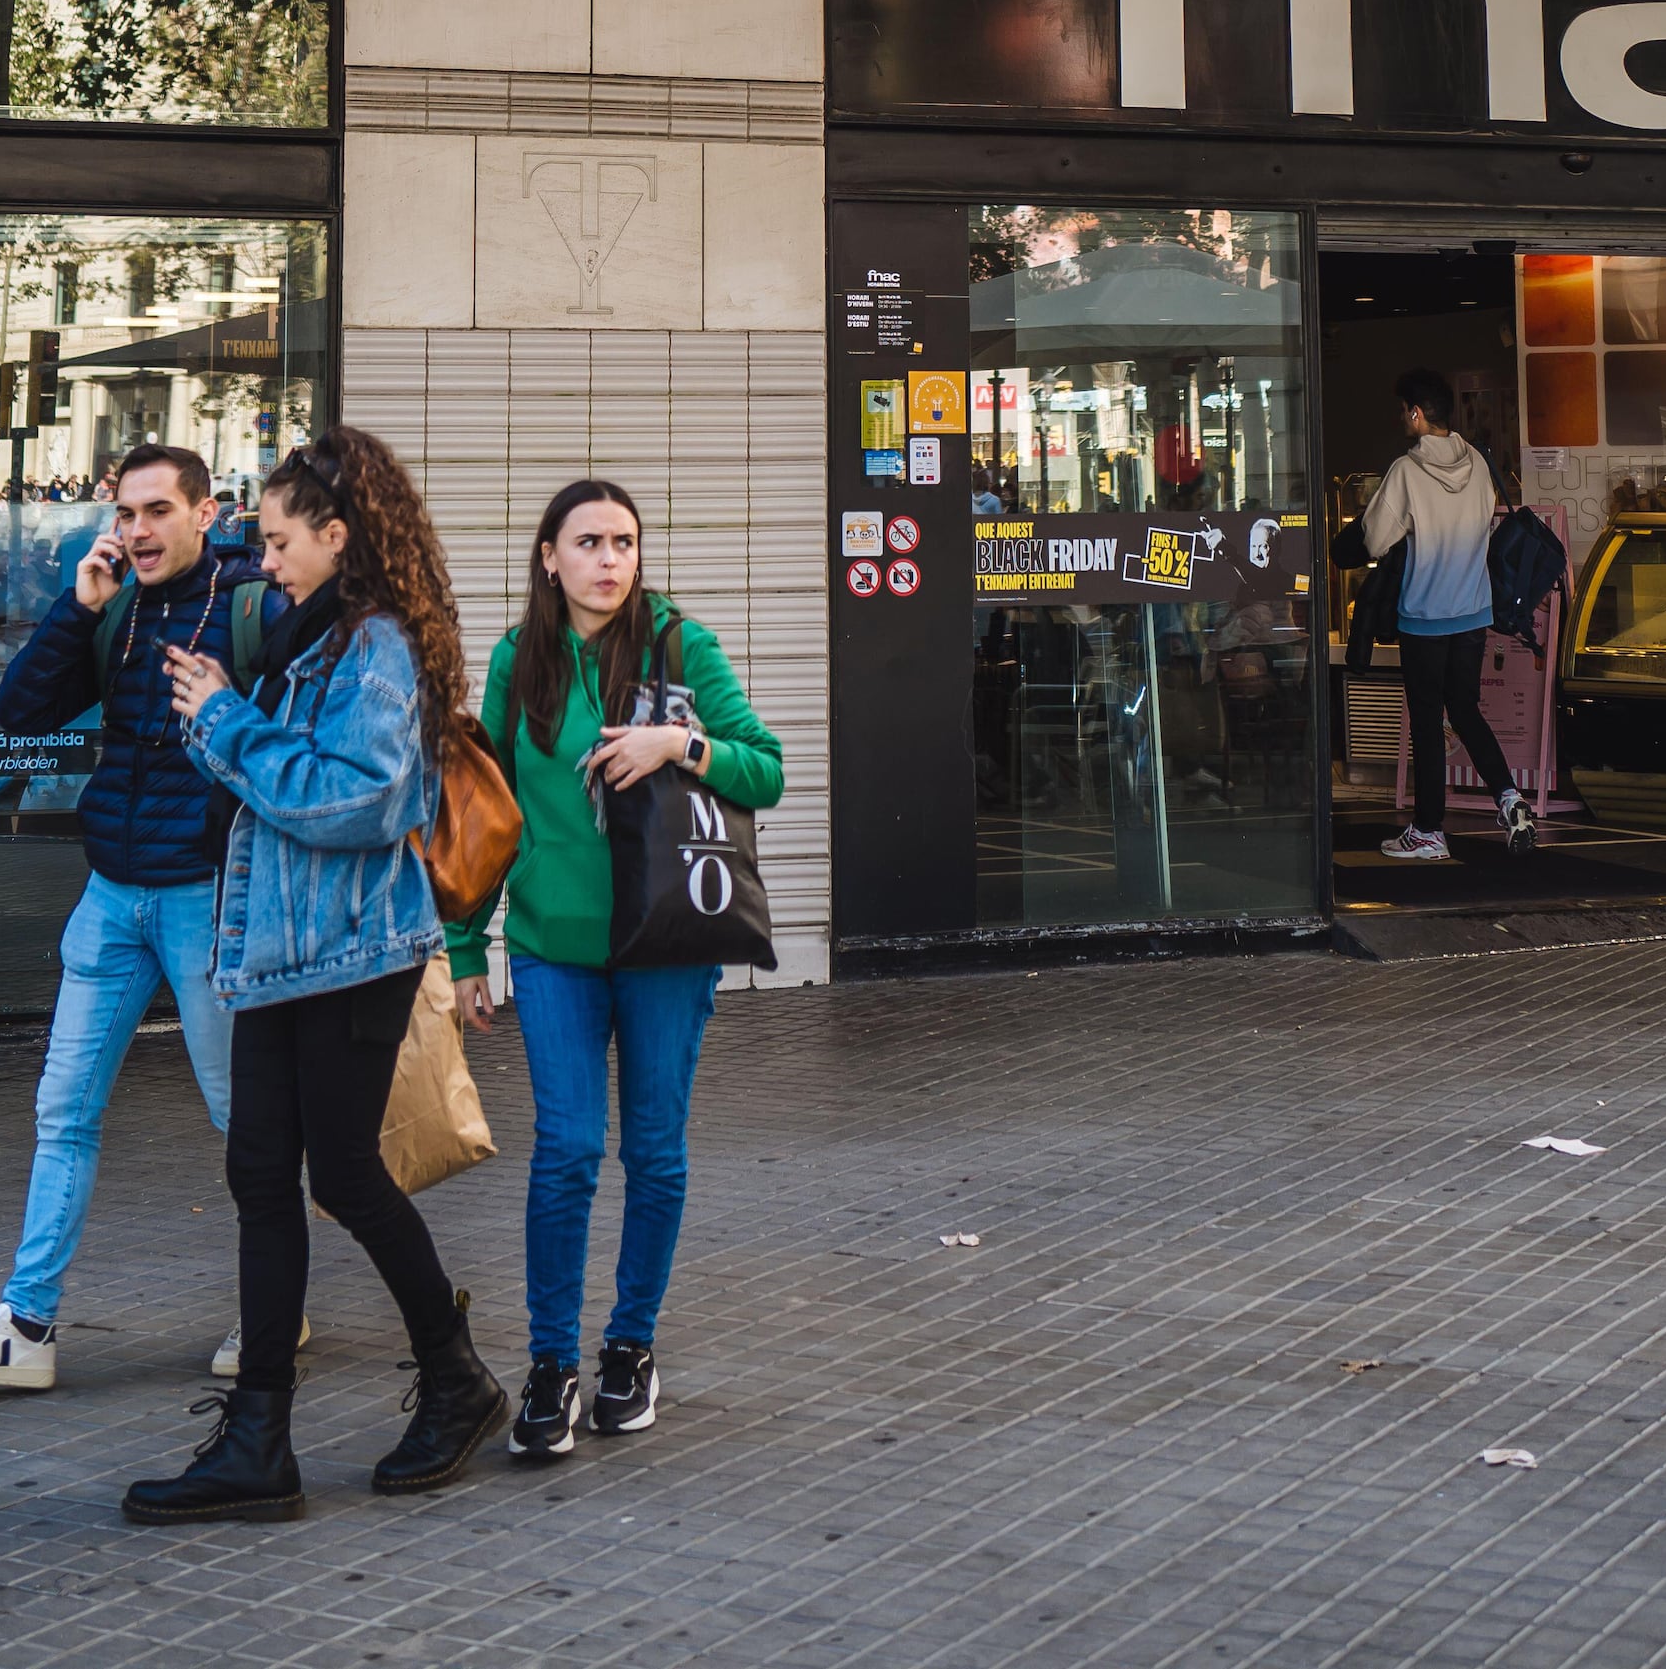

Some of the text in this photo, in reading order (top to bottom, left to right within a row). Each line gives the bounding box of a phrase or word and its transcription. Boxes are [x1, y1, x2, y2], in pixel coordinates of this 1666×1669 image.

[867, 270, 900, 282] fnac
[222, 339, 279, 359] T'ENXAM
[975, 522, 1034, 539] QUE AQUEST
[1151, 532, 1178, 550] FINS A
[975, 538, 1118, 575] BLACK FRIDAY
[1141, 547, 1190, 578] -50%
[975, 573, 1076, 591] T'ENXAMPI ENTRENAT
[686, 791, 731, 843] M
